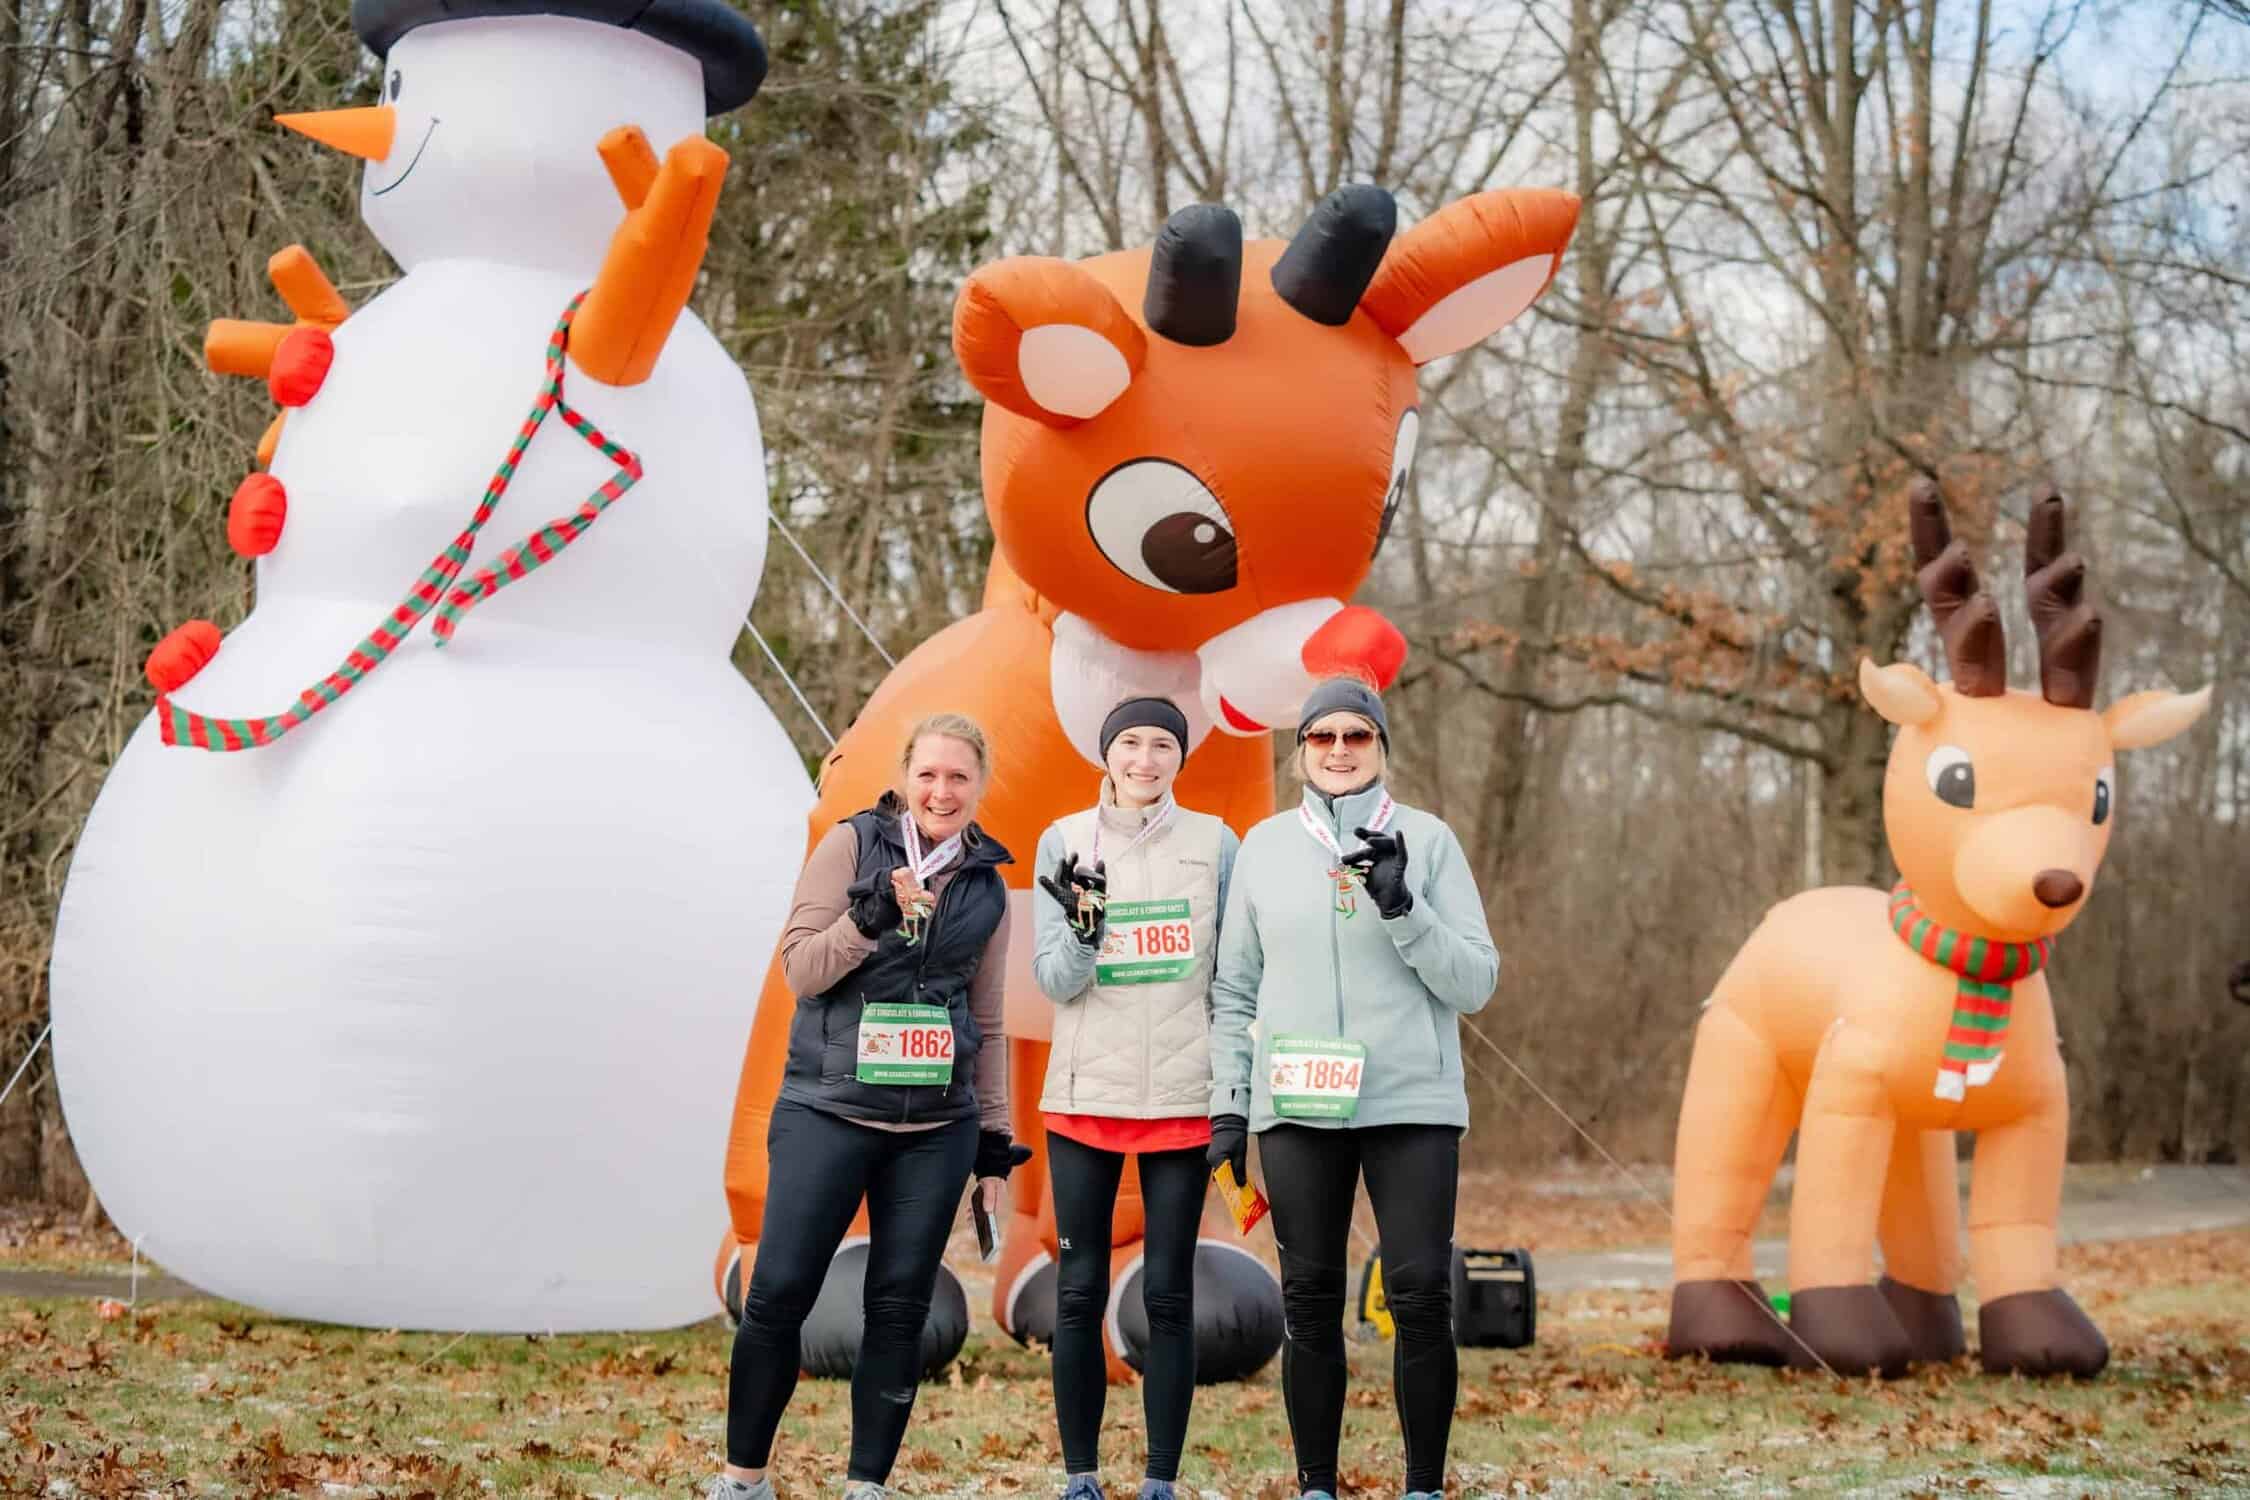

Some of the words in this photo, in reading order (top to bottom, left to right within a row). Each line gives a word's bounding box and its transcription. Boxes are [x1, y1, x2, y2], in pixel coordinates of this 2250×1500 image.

[1132, 923, 1190, 956] 1863
[899, 1029, 952, 1058] 1862
[1303, 1060, 1359, 1090] 1864
